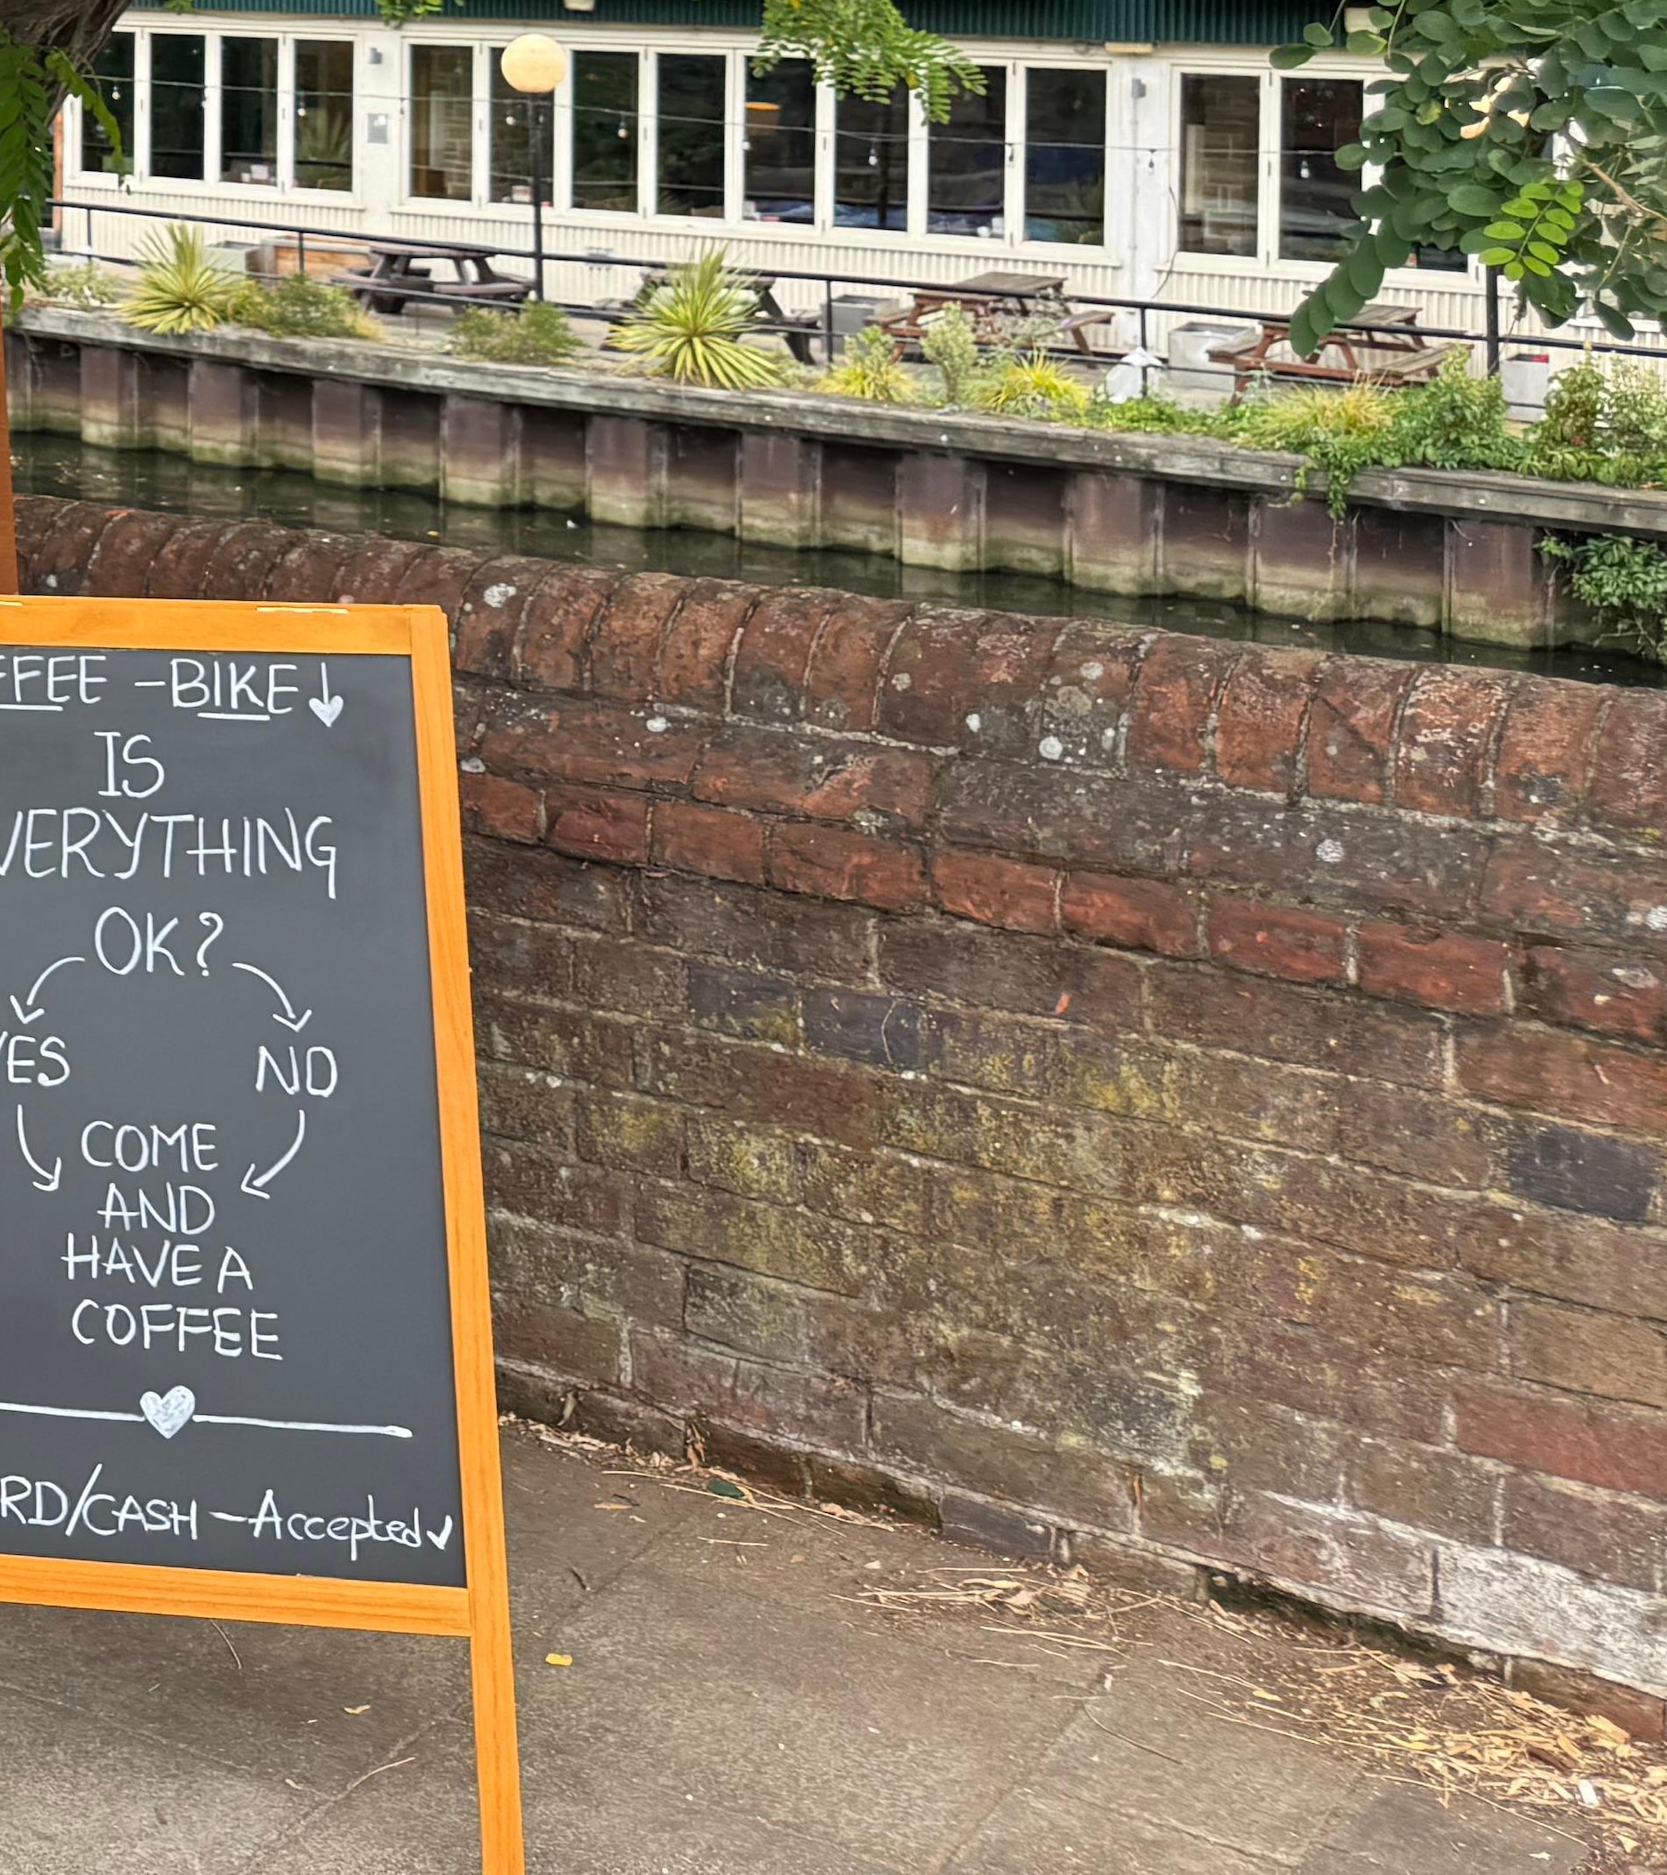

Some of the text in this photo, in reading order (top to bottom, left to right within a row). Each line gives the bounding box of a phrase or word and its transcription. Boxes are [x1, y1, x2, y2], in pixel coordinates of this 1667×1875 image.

[95, 731, 165, 798] IS
[255, 1045, 338, 1098] NO
[81, 1120, 219, 1173] COME
[97, 1183, 217, 1235] AND
[60, 1233, 254, 1293] HAVE A
[72, 1299, 284, 1361] COFFEE
